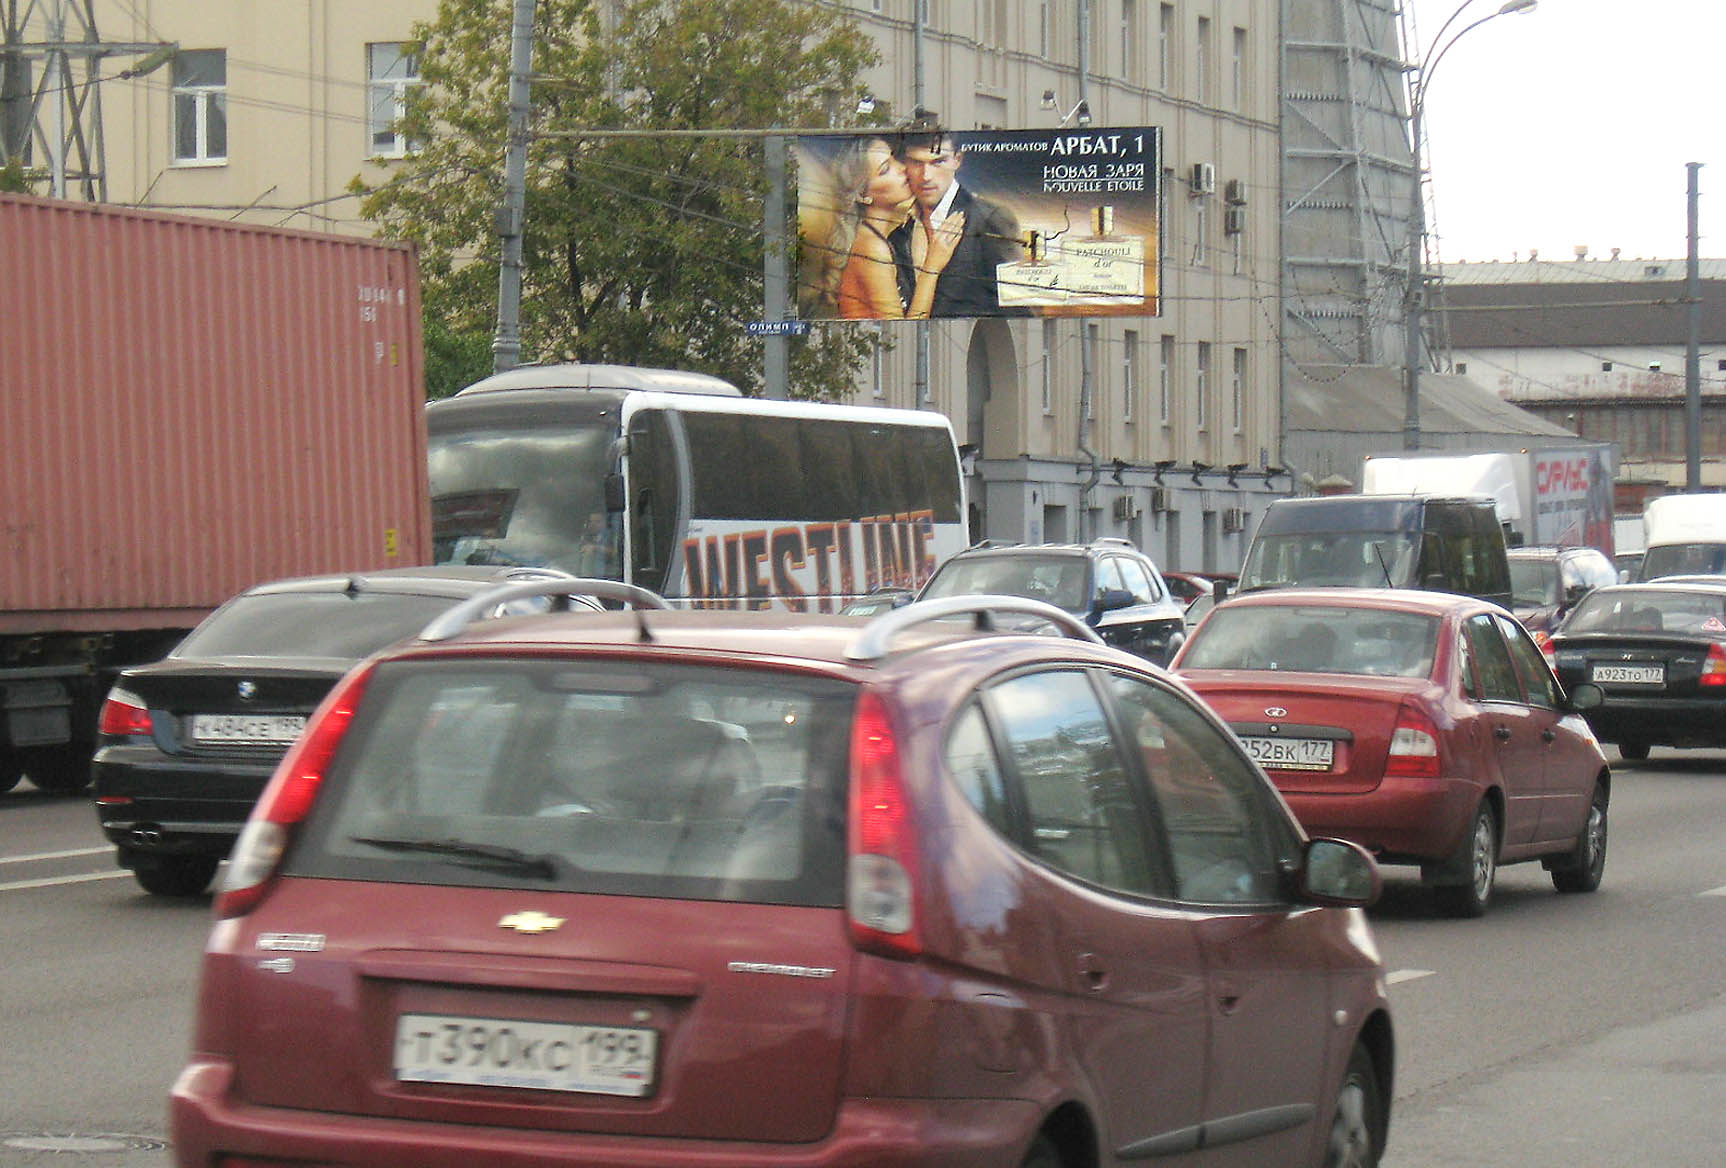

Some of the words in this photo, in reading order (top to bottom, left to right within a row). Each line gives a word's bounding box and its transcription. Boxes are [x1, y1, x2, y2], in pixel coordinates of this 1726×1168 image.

[994, 142, 1049, 152] АРОМАТОВ
[1050, 135, 1128, 158] АРБАТ,
[1134, 134, 1145, 153] 1
[1043, 164, 1098, 179] НОВАЯ
[1105, 163, 1145, 178] ЗАРЯ
[1043, 180, 1102, 193] NOUVELLE
[1106, 180, 1145, 192] ETOILE
[1301, 740, 1329, 758] 177
